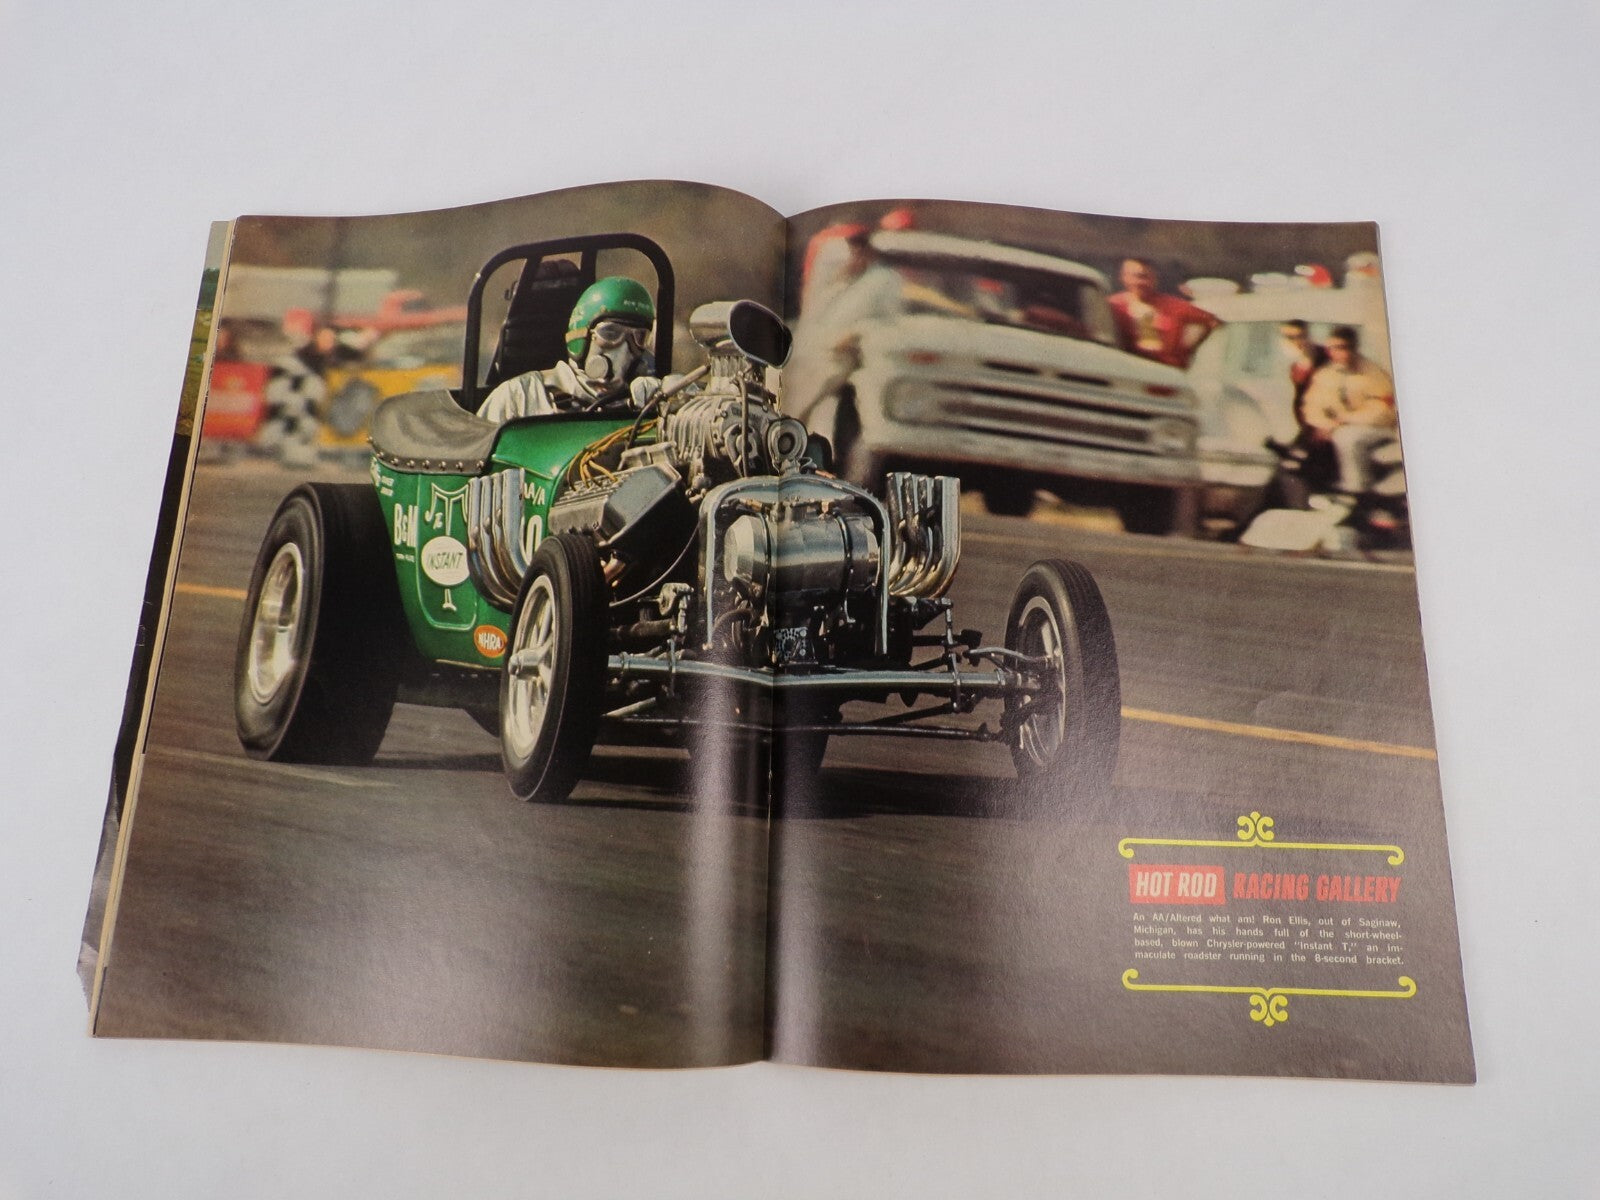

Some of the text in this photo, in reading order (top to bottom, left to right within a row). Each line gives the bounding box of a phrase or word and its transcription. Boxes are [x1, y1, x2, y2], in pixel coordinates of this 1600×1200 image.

[427, 552, 463, 569] INSTANT
[478, 632, 502, 650] NHRA
[1136, 872, 1401, 903] HOT ROD RACING GALLERY
[1133, 913, 1145, 921] An
[1153, 913, 1202, 923] AA/Altered
[1209, 915, 1230, 923] what
[1263, 916, 1281, 924] Ron
[1289, 916, 1311, 926] Ellis,
[1319, 917, 1333, 925] out
[1342, 917, 1351, 925] of
[1359, 918, 1400, 928] Saginaw,
[1134, 926, 1402, 940] Michigan, has his hands full of the short-wheel-
[1135, 938, 1163, 947] based,
[1172, 939, 1198, 947] blown
[1207, 939, 1285, 949] Chrysler-powered
[1388, 944, 1403, 952] im-
[1135, 951, 1175, 959] maculate
[1184, 952, 1221, 960] roadster
[1230, 953, 1265, 962] running
[1315, 955, 1357, 964] 8-second
[1367, 956, 1404, 965] bracket.
